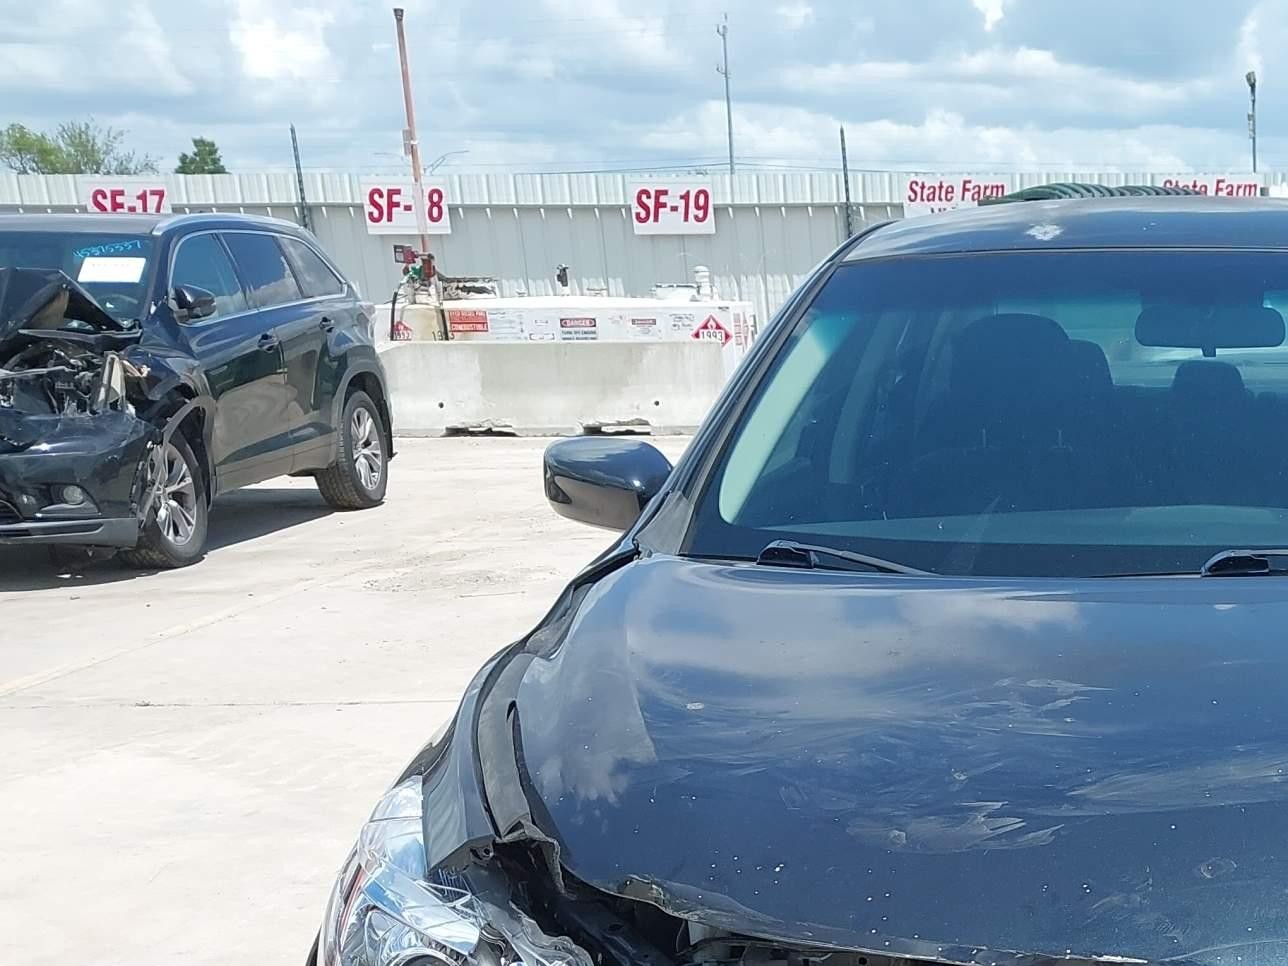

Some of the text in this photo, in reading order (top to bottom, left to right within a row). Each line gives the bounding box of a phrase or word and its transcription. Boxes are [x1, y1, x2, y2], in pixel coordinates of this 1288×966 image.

[91, 188, 165, 213] SF-17
[907, 179, 1006, 203] State Farm
[368, 188, 444, 223] SF-8
[635, 188, 710, 223] SF-19
[701, 330, 723, 341] 1993
